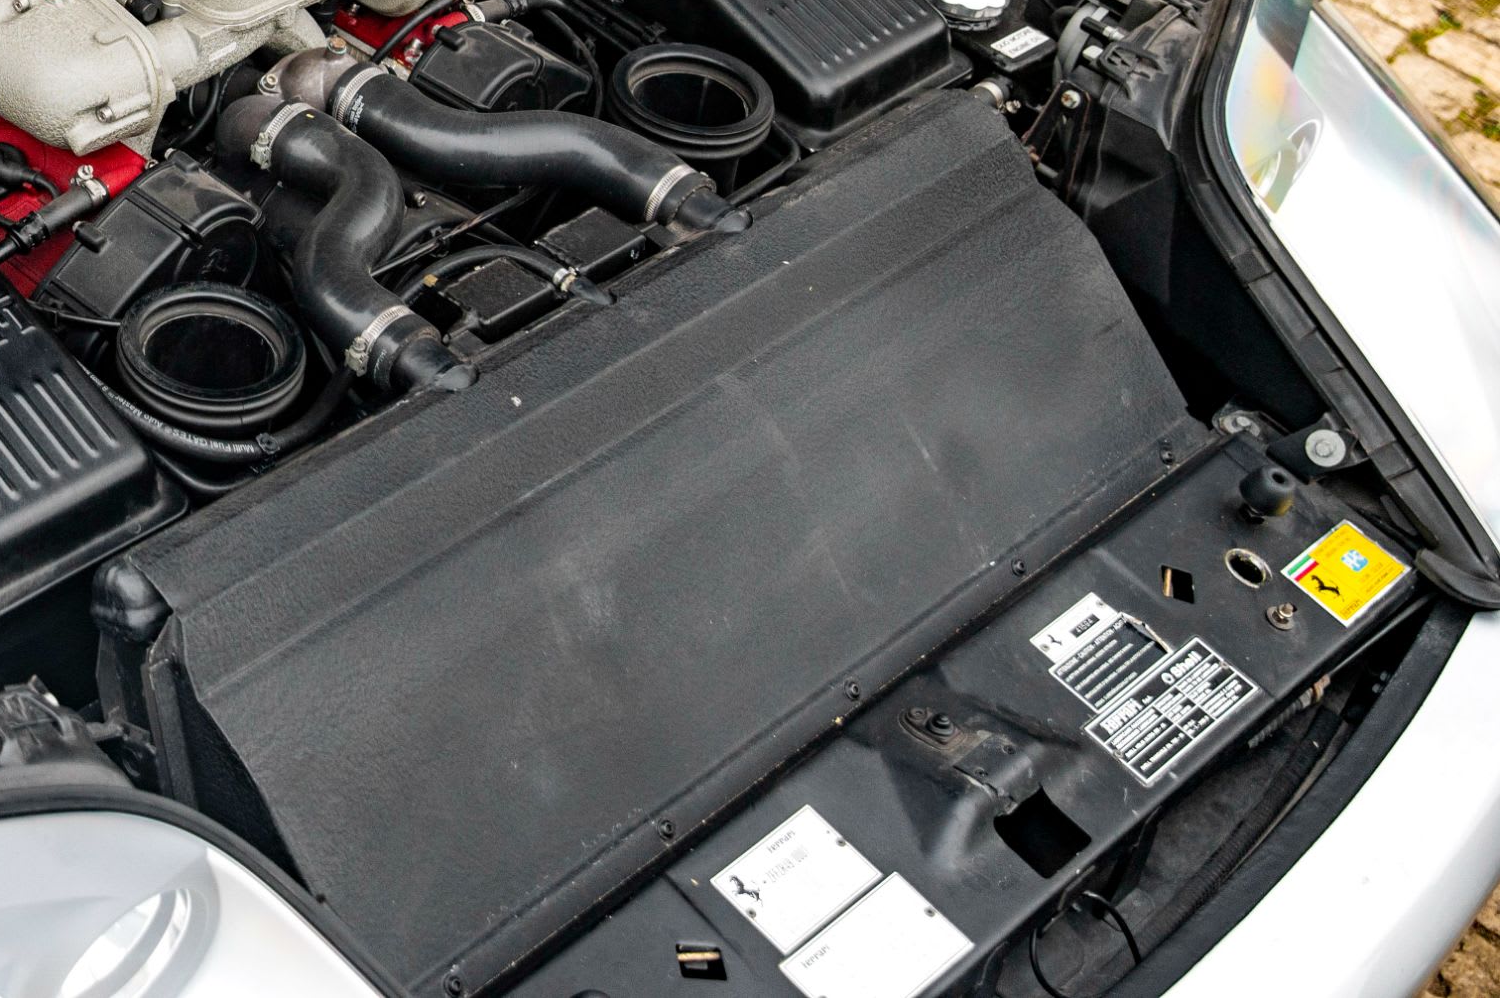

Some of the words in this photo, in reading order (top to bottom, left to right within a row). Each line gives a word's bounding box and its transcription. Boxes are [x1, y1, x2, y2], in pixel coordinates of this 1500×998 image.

[143, 411, 164, 428] Auto
[210, 440, 232, 453] Fuel
[1173, 650, 1202, 679] Shell
[765, 829, 797, 854] Ferrari
[800, 942, 830, 969] Ferrari
